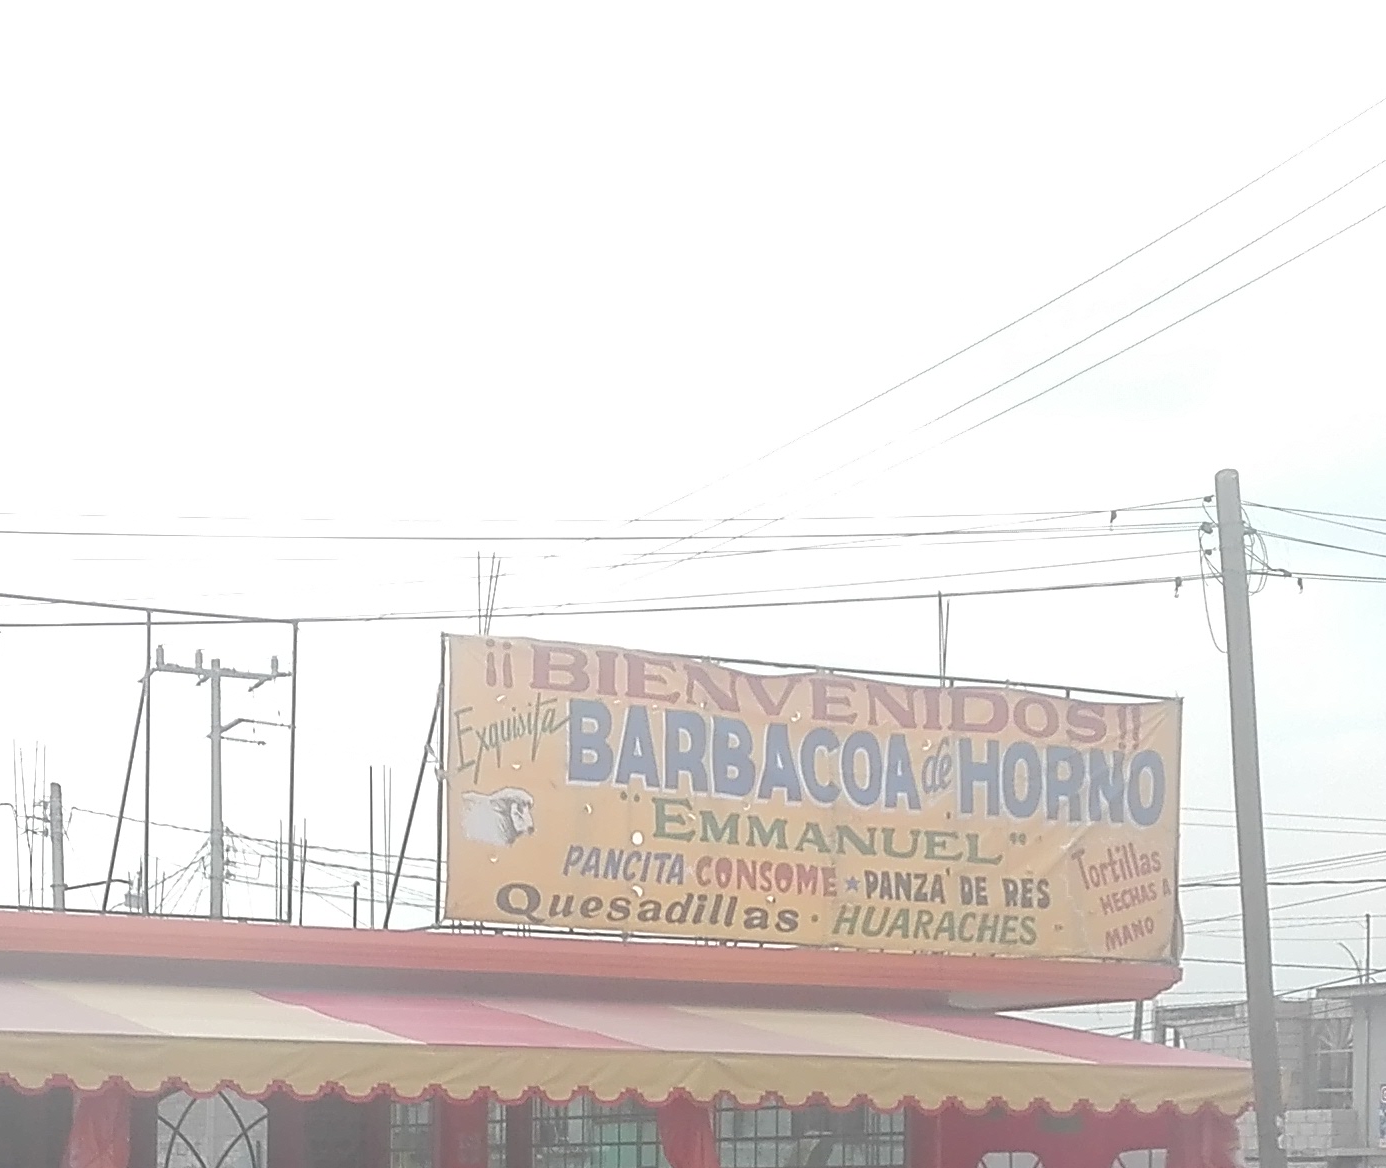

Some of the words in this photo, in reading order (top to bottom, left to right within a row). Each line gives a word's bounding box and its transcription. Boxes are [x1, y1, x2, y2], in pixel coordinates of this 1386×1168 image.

[453, 691, 572, 786] Exquisita
[566, 697, 921, 812] BARBACOA
[920, 734, 954, 795] de
[955, 736, 1167, 829] HORNO
[562, 845, 685, 886] PANCITA
[695, 855, 839, 898] CONSOME
[863, 868, 947, 905] PANZA
[959, 875, 989, 906] DE
[1001, 877, 1052, 910] RES
[1070, 842, 1163, 891] Tortillas
[494, 881, 801, 934] Quesadillas
[830, 904, 1038, 947] HUARACHES
[1099, 881, 1158, 916] HECHAS
[1162, 877, 1173, 897] A
[1104, 915, 1155, 952] MANO
